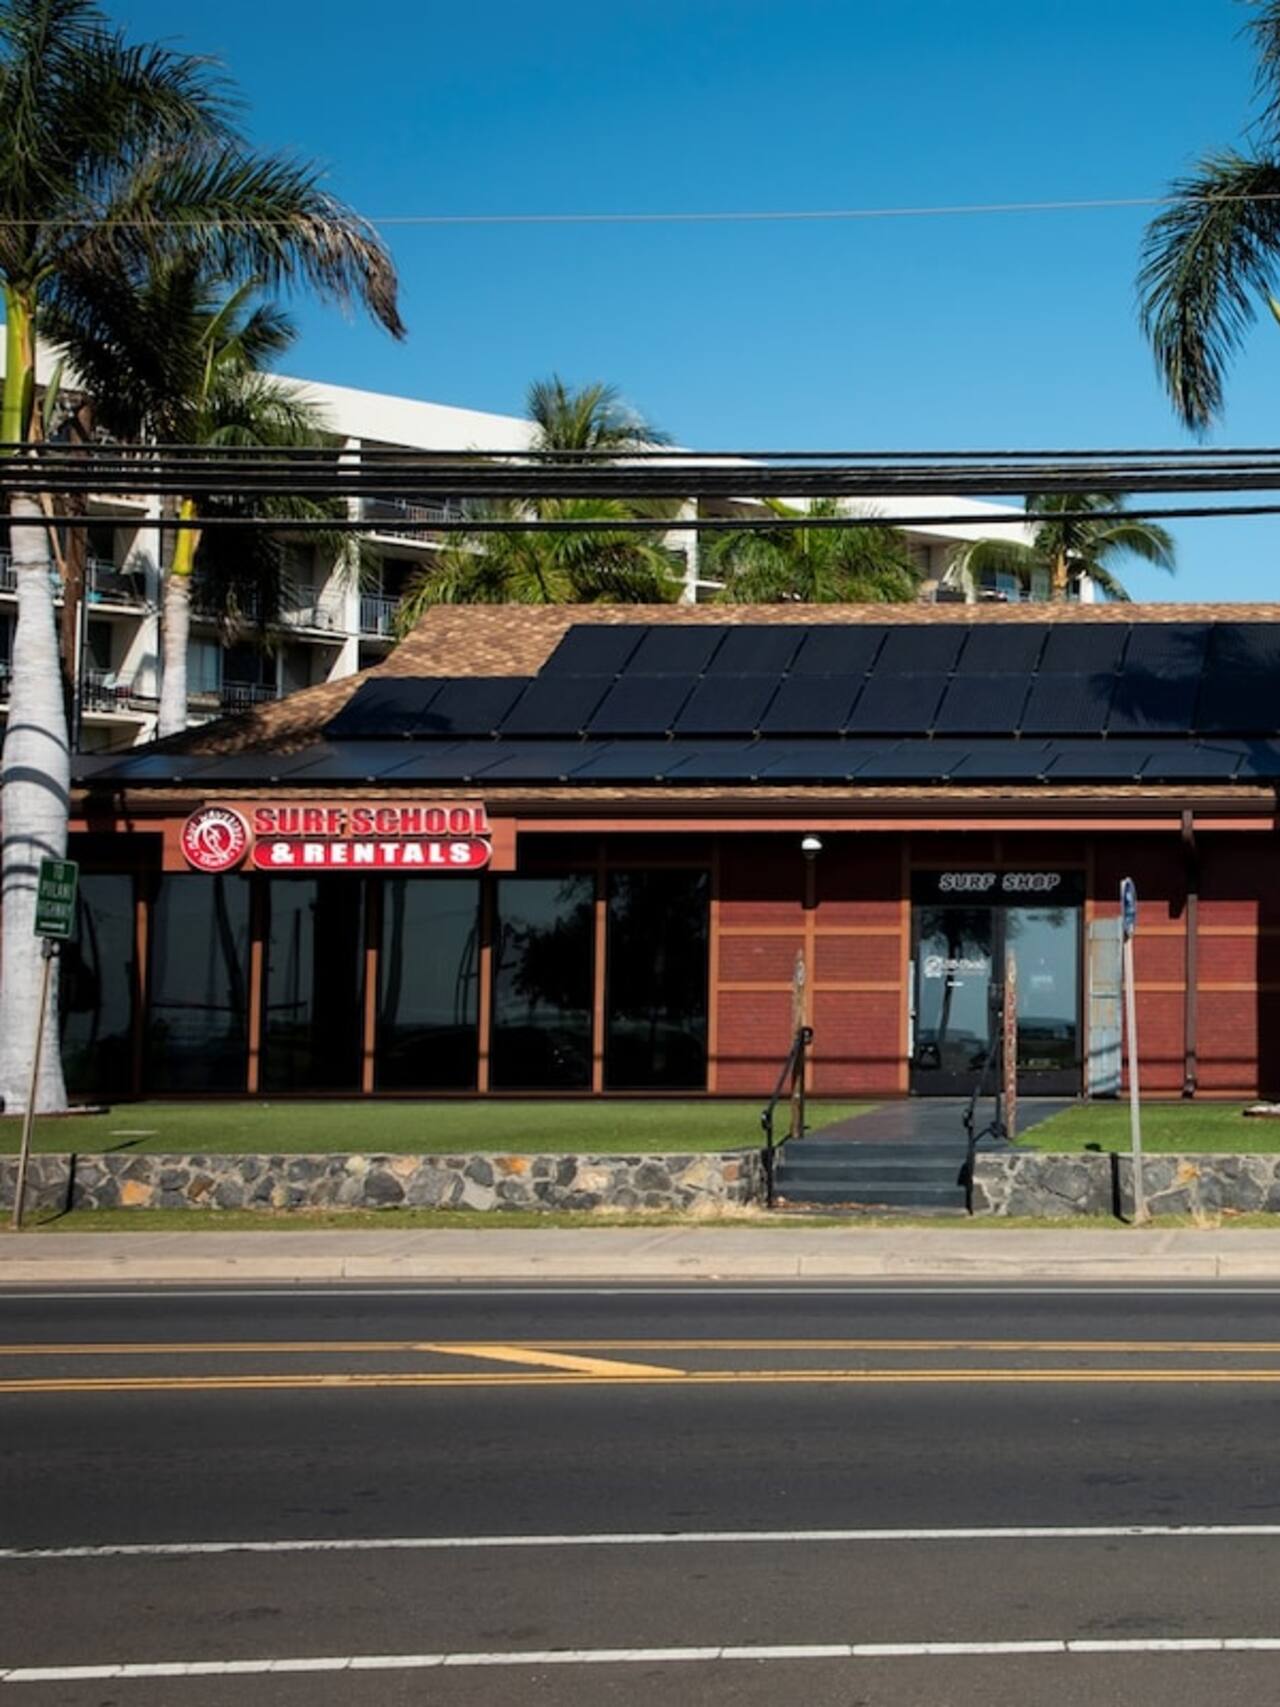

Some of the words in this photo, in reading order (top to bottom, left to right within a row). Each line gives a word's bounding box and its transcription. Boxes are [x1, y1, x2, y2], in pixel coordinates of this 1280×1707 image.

[254, 807, 346, 834] SURF
[351, 807, 490, 834] SCHOOL
[270, 842, 295, 864] &
[303, 842, 472, 864] RENTALS
[938, 873, 996, 891] SURF
[1002, 873, 1061, 891] SHOP
